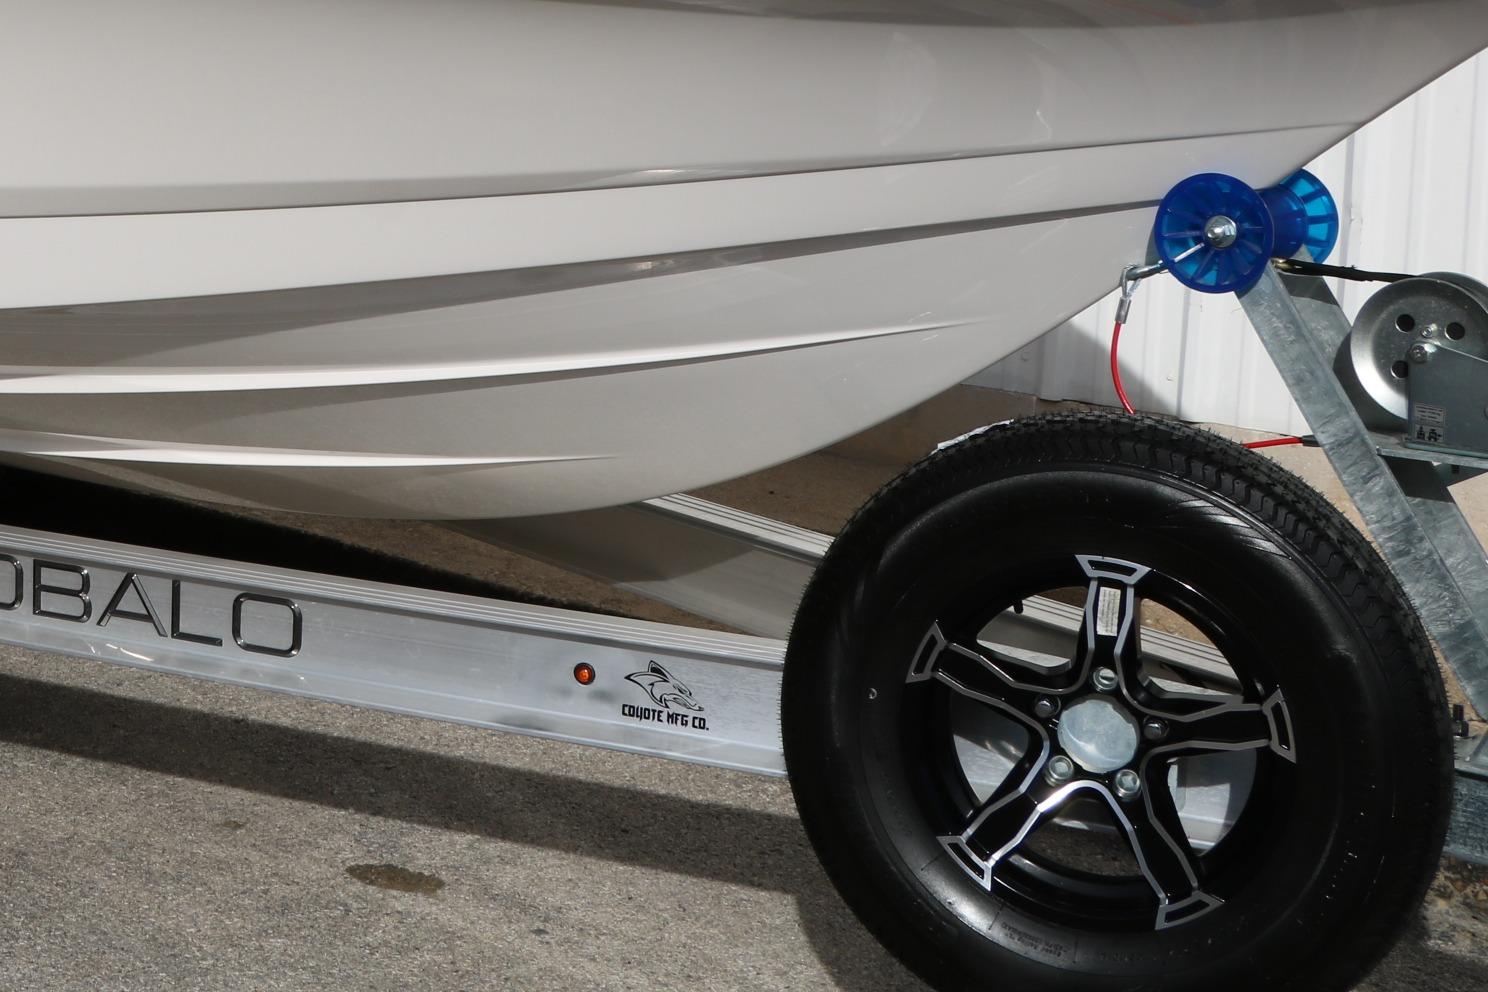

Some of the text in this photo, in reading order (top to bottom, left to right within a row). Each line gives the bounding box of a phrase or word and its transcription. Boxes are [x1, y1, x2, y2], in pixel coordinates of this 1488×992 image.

[621, 703, 710, 731] COYOTE MFG CO.
